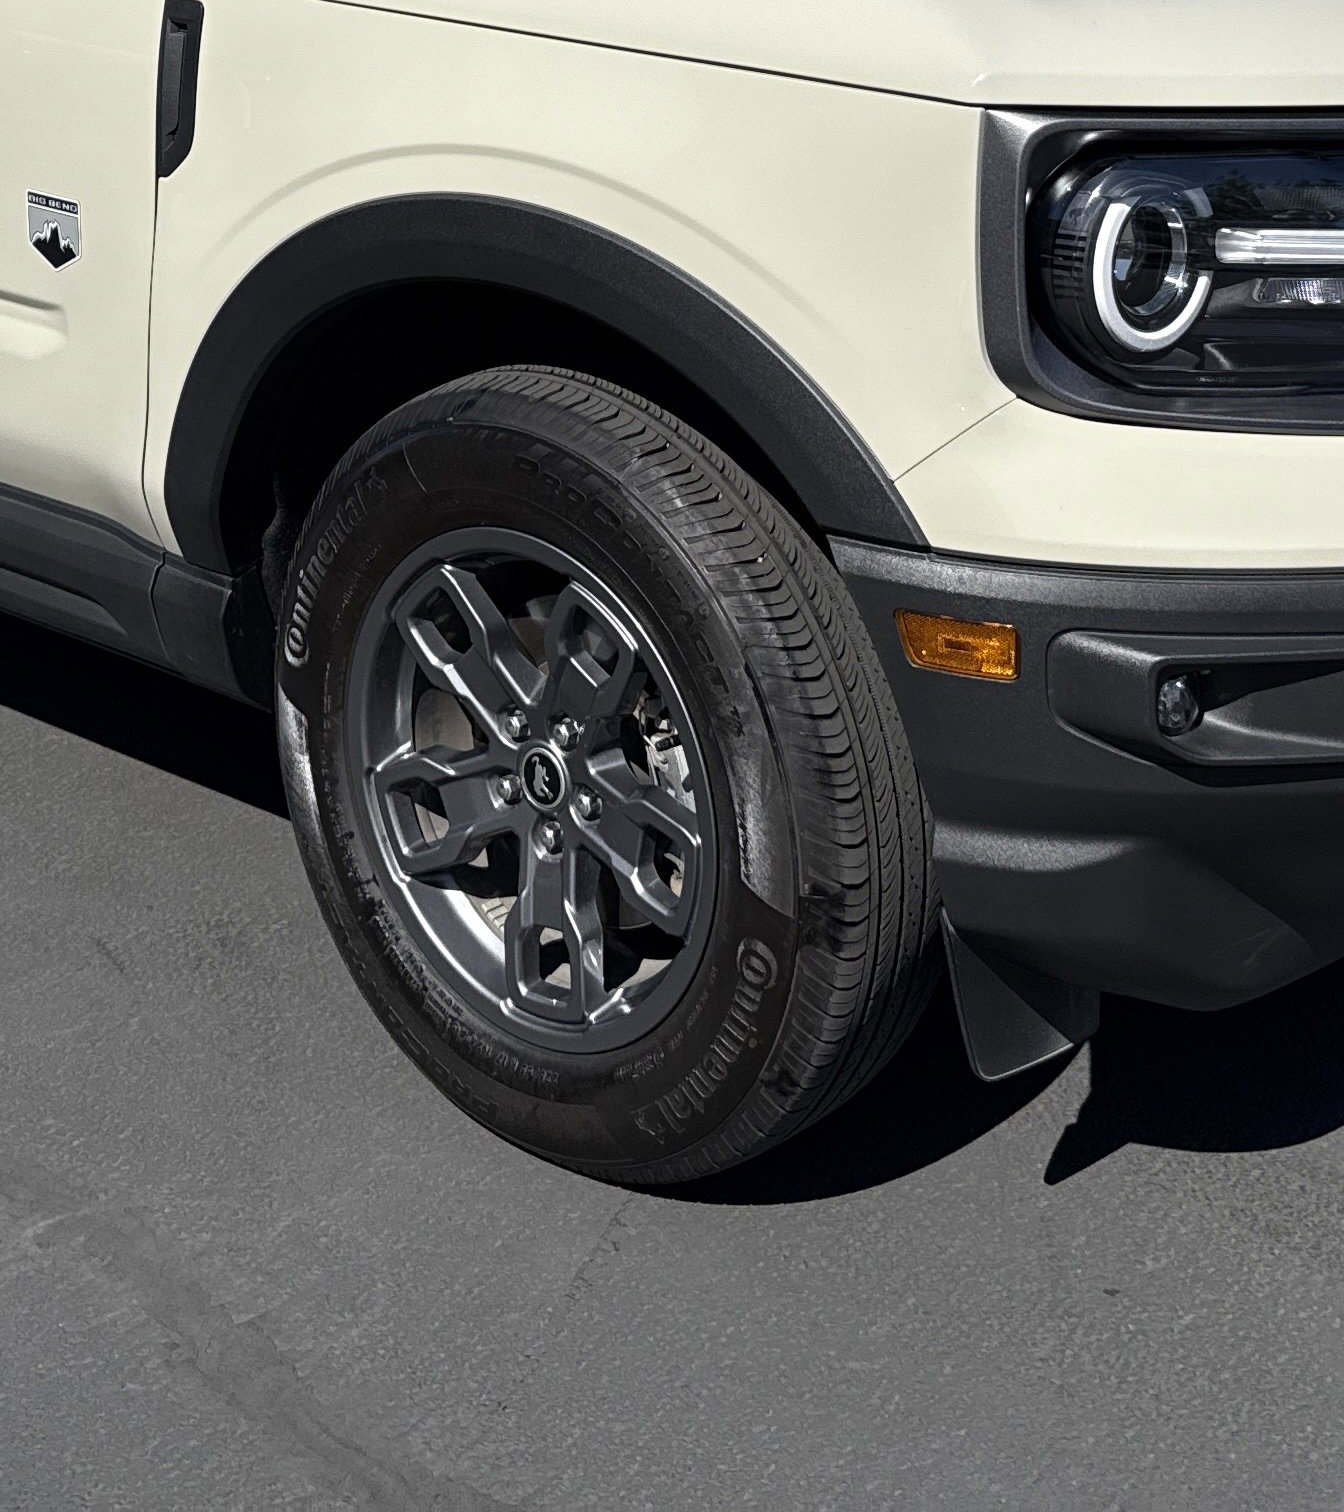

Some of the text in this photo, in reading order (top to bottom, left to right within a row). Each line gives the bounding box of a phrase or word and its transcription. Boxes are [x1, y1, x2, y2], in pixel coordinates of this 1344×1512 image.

[28, 194, 78, 213] BIG BEND
[283, 479, 369, 669] Continental
[655, 935, 779, 1135] Continental
